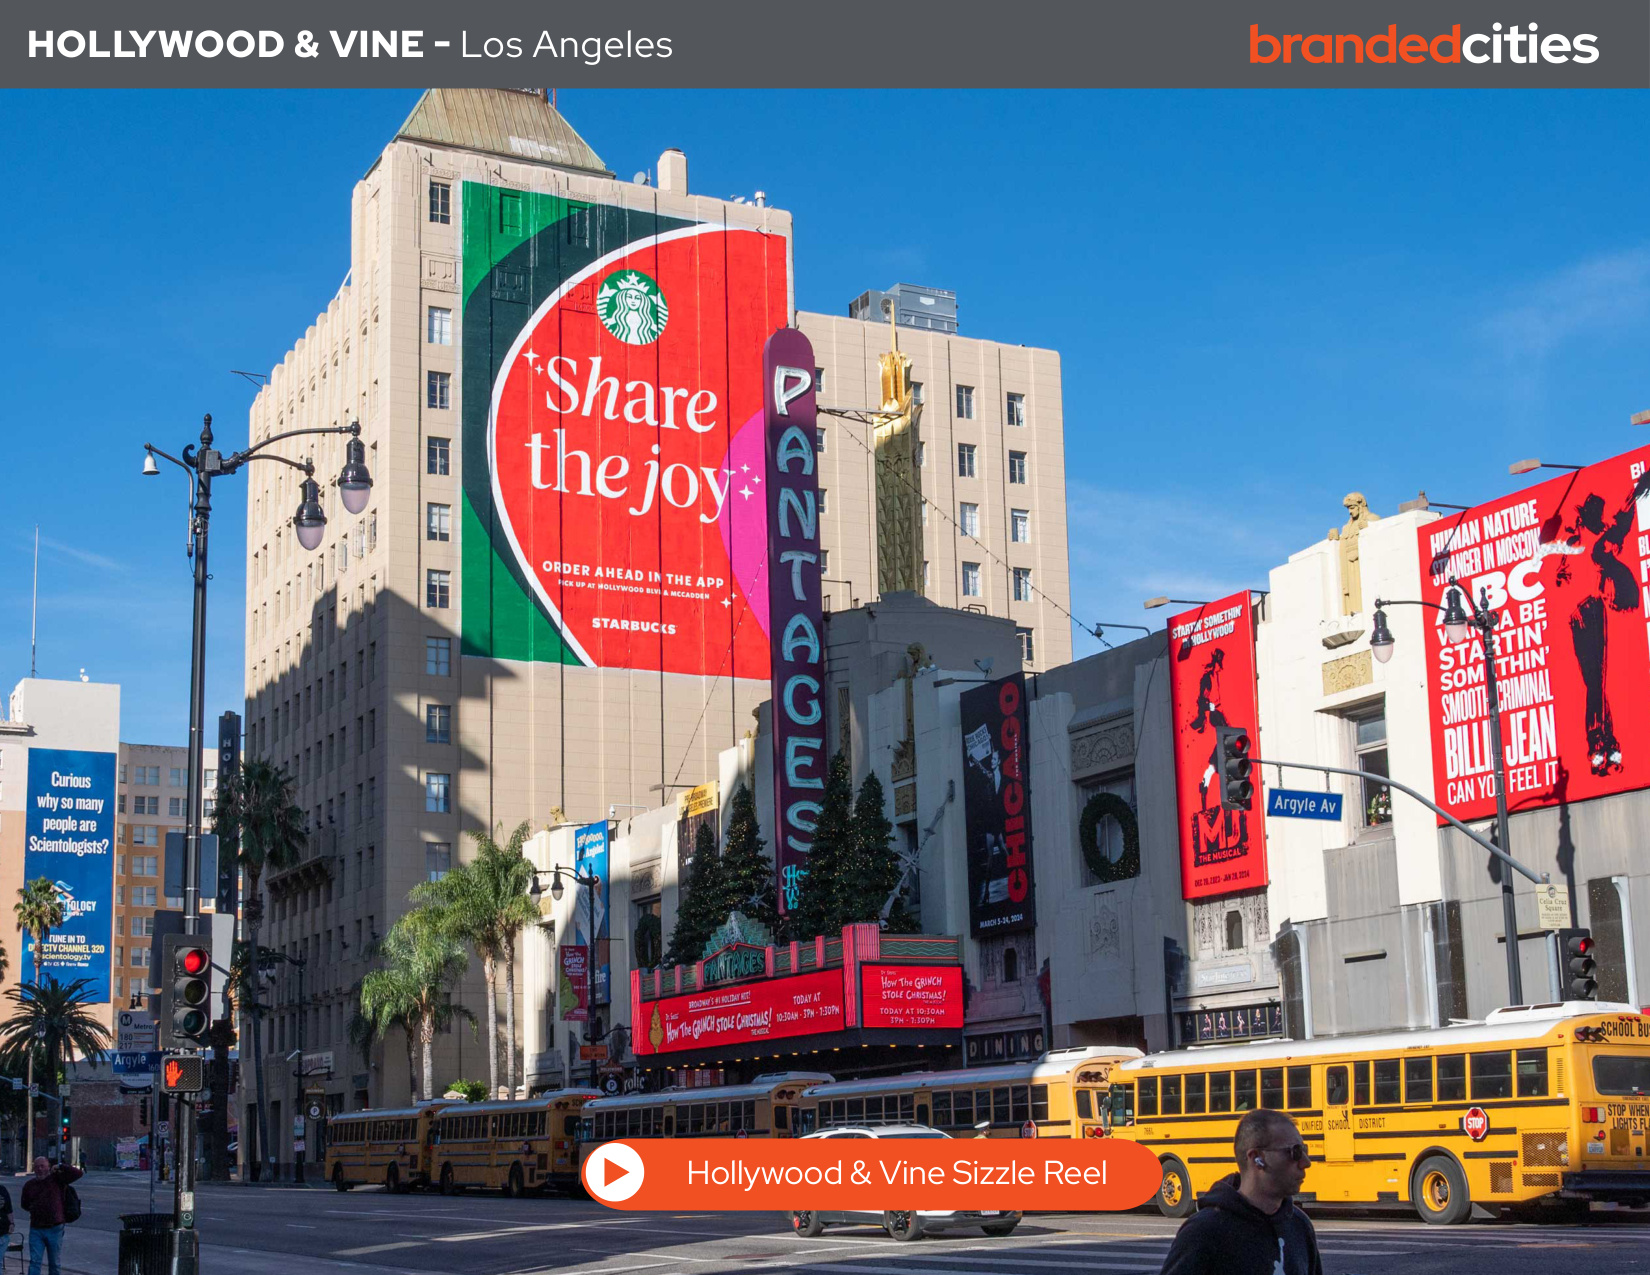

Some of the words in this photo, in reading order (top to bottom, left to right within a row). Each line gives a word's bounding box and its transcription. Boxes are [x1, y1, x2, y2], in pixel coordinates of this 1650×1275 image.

[545, 355, 718, 433] Share
[524, 428, 629, 498] the
[628, 443, 737, 523] joy
[1430, 519, 1481, 559] HUMAN
[1482, 499, 1539, 540] NATURE
[1432, 547, 1482, 587] STRANGER
[1482, 542, 1496, 571] IN
[1495, 526, 1542, 567] MOSCOW
[542, 560, 590, 577] ORDER
[594, 566, 644, 582] AHEAD
[648, 571, 662, 584] IN
[666, 573, 692, 587] THE
[696, 576, 724, 589] APP
[558, 578, 574, 588] PICK
[575, 580, 586, 588] UP
[597, 583, 644, 594] HOLLYWOOD
[670, 590, 710, 600] MCCADDEN
[1435, 559, 1546, 627] ABC
[774, 365, 825, 853] PANTAGES
[592, 617, 677, 635] STARBUCKS
[1436, 609, 1515, 647] WNA
[1519, 598, 1547, 624] BE
[1190, 620, 1235, 647] HOLLYWOOD
[1440, 645, 1550, 691] SOMTHIN'
[1495, 668, 1554, 713] CRIMINAL
[1443, 719, 1495, 780] BILLI
[1505, 703, 1557, 767] JEAN
[51, 770, 92, 789] Curious
[1447, 778, 1475, 805] CAN
[1477, 774, 1497, 799] YO
[1509, 764, 1542, 793] FEEL
[1545, 760, 1559, 786] IT
[999, 681, 1028, 903] CHICAGO
[37, 793, 58, 812] why
[61, 796, 74, 810] so
[75, 797, 104, 813] many
[1274, 794, 1316, 814] Argyle
[1319, 799, 1336, 814] Av
[43, 815, 77, 834] people
[79, 819, 97, 832] are
[29, 836, 109, 857] Scientologists?
[1199, 854, 1212, 863] THE
[1212, 848, 1242, 860] MUSICAL
[49, 934, 67, 944] TUNE
[67, 935, 76, 944] IN
[76, 935, 86, 944] TO
[58, 944, 91, 953] CHANNEL
[91, 944, 105, 954] 320
[703, 950, 766, 983] PANTAGES
[881, 975, 898, 989] How
[898, 977, 913, 987] The
[914, 976, 943, 990] GRINCH
[792, 993, 812, 1006] TODAY
[812, 992, 822, 1002] AT
[881, 990, 904, 1000] STOLE
[776, 1011, 799, 1023] 10:30AM
[803, 1008, 815, 1019] 3PM
[819, 1005, 840, 1017] 7:30PM
[880, 1007, 903, 1015] TODAY
[905, 1007, 915, 1015] AT
[916, 1008, 945, 1016] 10:30AM
[890, 1016, 904, 1024] 3PM
[910, 1016, 936, 1025] 7:30PM
[120, 1033, 133, 1041] 180
[665, 1022, 680, 1044] How
[679, 1021, 692, 1038] The
[692, 1015, 715, 1040] GRINCH
[716, 1014, 735, 1034] STOLE
[1601, 1021, 1635, 1037] SCHOOL
[119, 1042, 132, 1050] 217
[969, 1034, 1043, 1058] DINING
[114, 1053, 147, 1067] Argyle
[623, 1066, 645, 1092] rolic
[1607, 1104, 1627, 1117] STOP
[1628, 1104, 1650, 1117] WHEN
[1301, 1120, 1323, 1131] UNIFIED
[1327, 1119, 1351, 1131] SCHOOL
[1358, 1117, 1386, 1129] DISTRICT
[1467, 1117, 1485, 1129] STOP
[1612, 1117, 1638, 1130] LIGHTS
